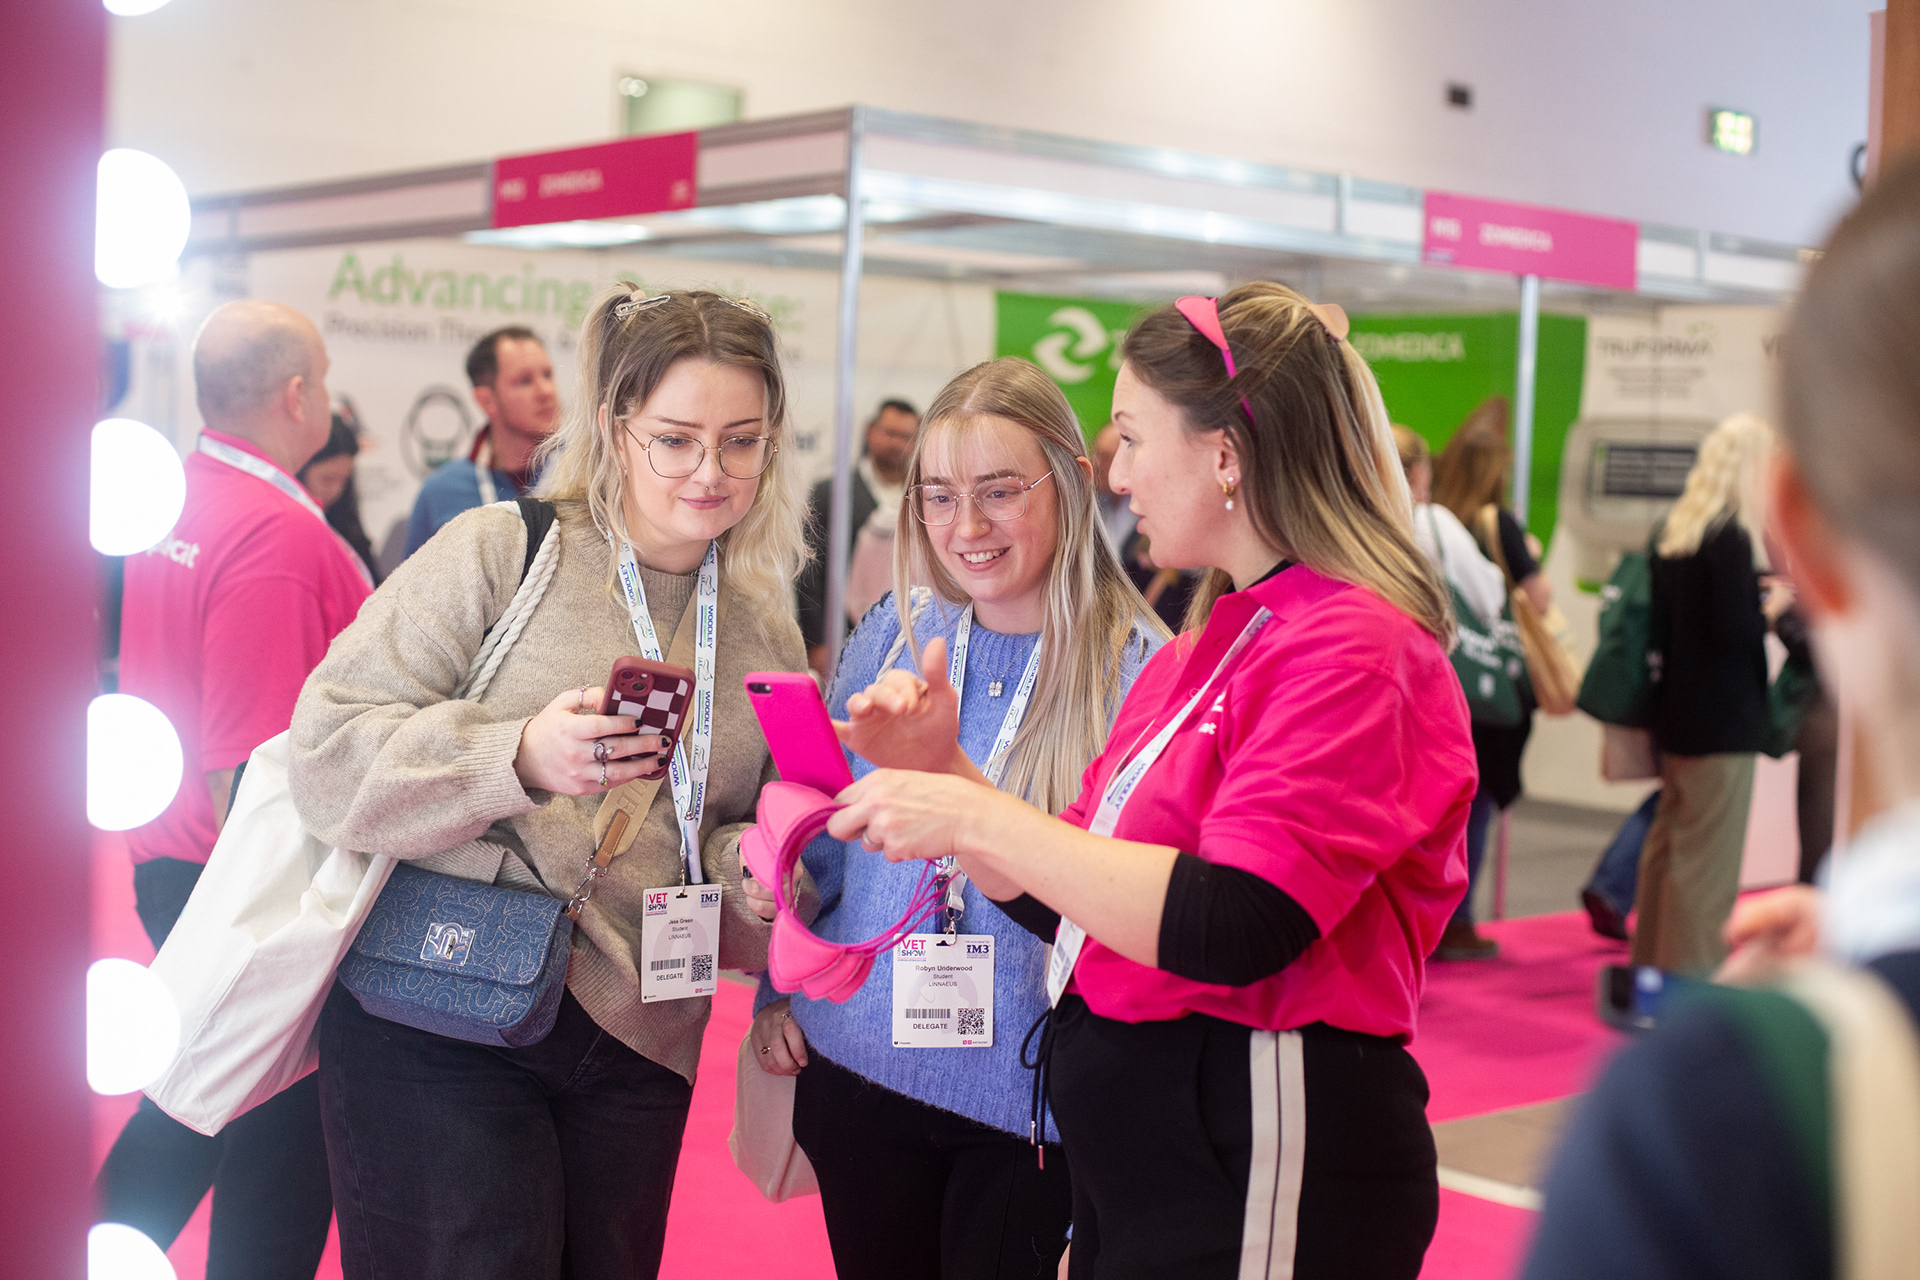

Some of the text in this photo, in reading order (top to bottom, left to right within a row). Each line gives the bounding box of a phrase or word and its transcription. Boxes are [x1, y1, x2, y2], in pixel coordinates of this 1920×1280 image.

[329, 251, 591, 330] Advancing
[620, 563, 637, 607] WOODLEY
[703, 691, 711, 737] WOODLEY
[648, 892, 668, 904] VET
[648, 903, 668, 911] SHOW
[902, 940, 926, 949] VET
[915, 965, 935, 973] Robyn
[656, 973, 683, 981] DELEGATE
